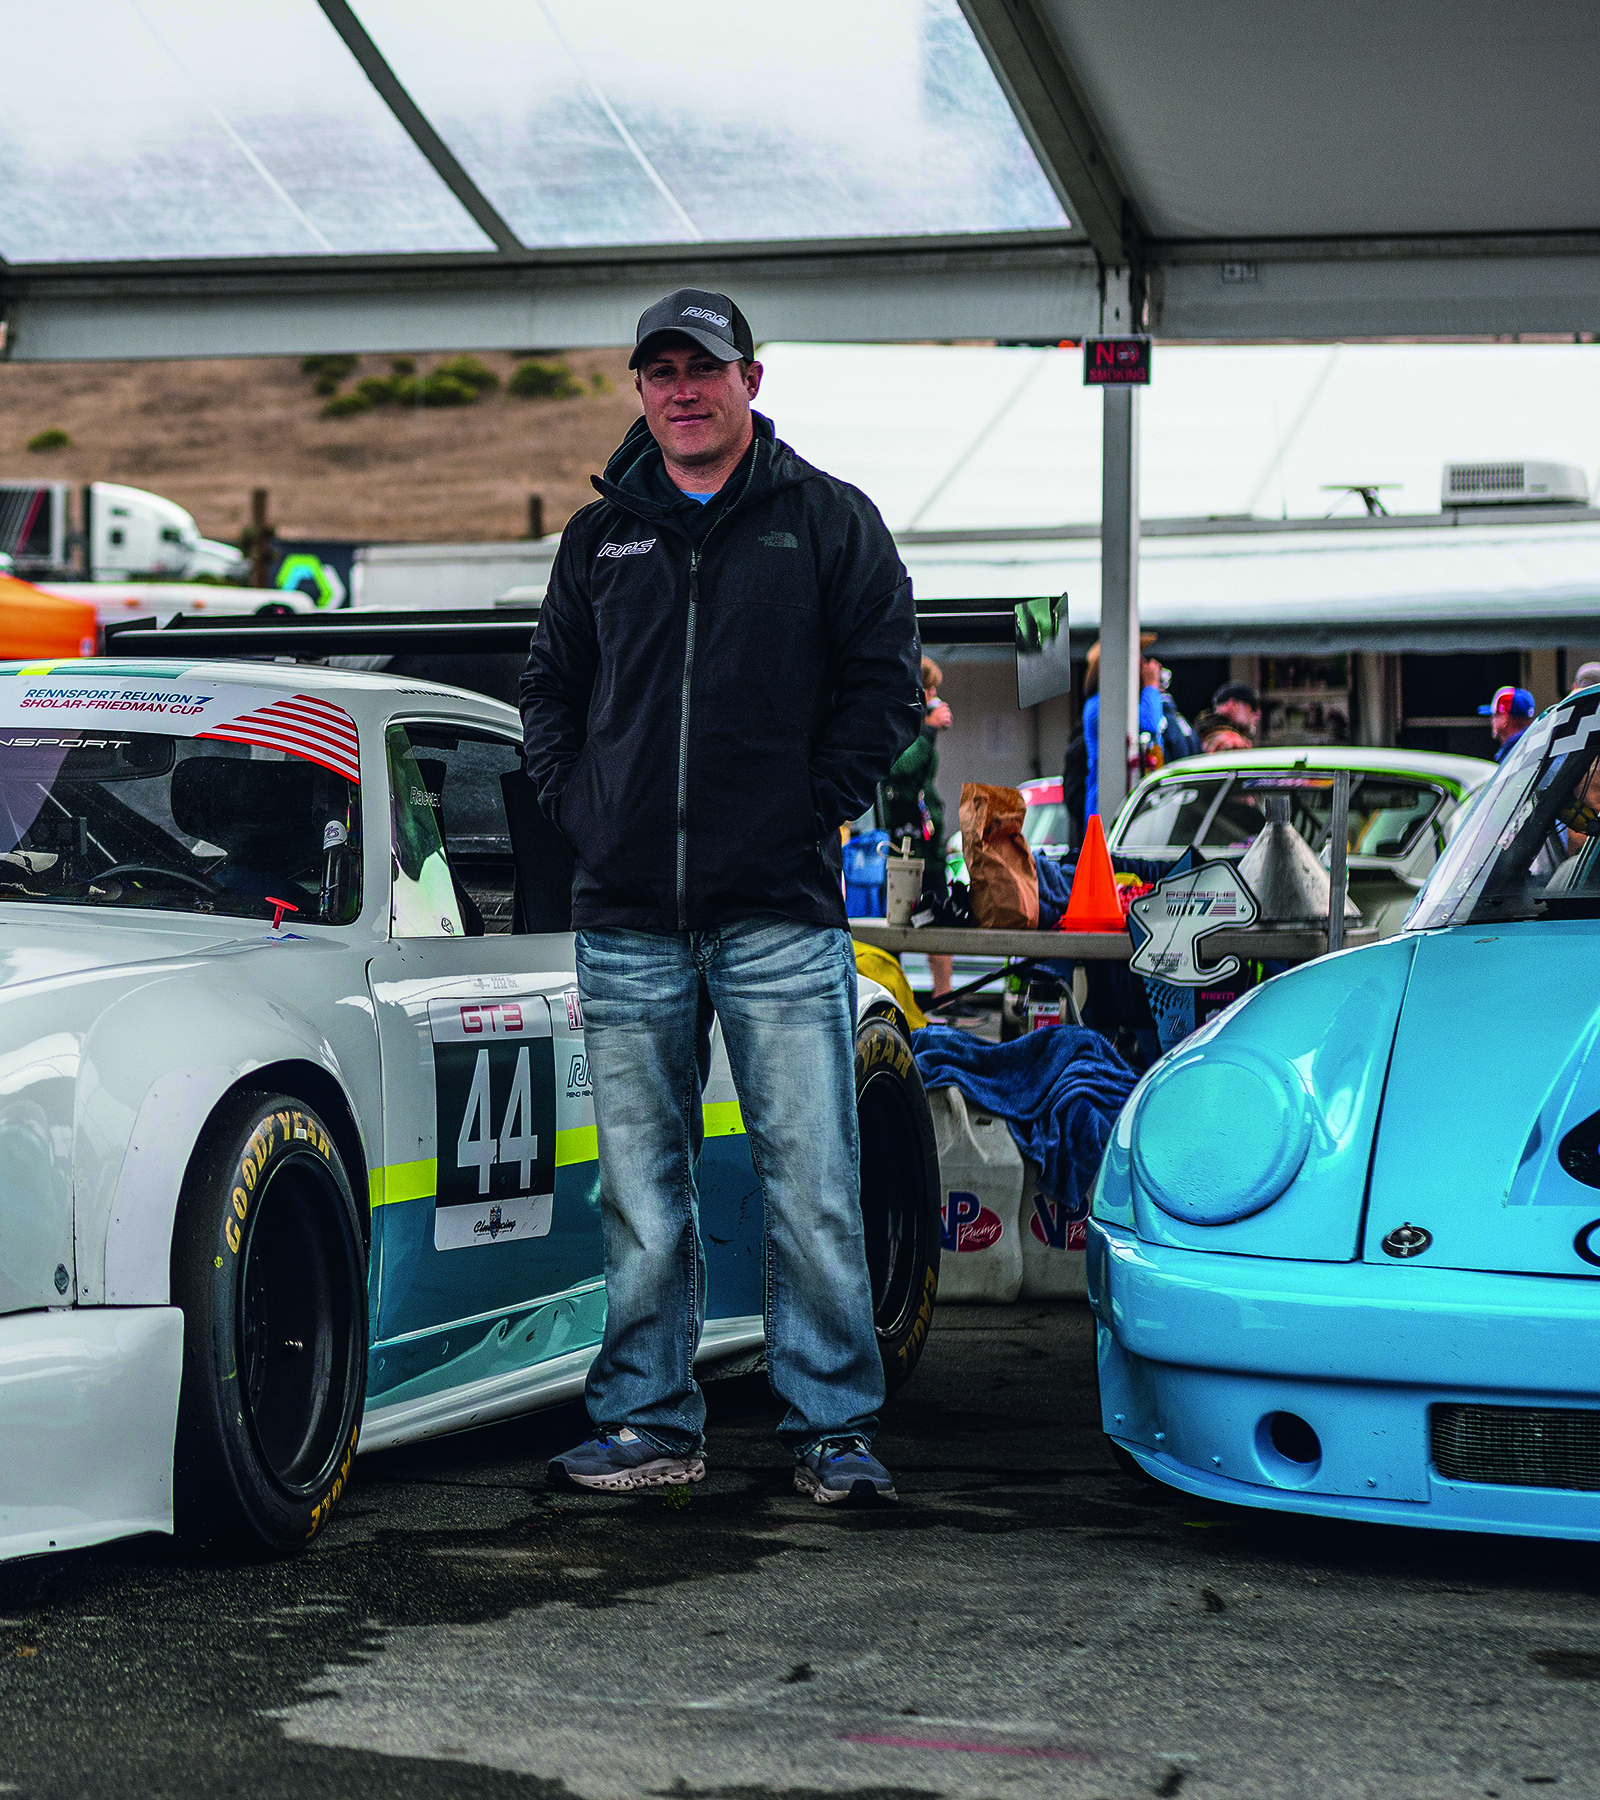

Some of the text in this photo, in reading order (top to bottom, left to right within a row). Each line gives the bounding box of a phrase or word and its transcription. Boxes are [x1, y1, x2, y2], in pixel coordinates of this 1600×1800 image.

[680, 306, 730, 328] RRS
[1088, 367, 1147, 383] SMOKING
[597, 539, 657, 558] RRS
[24, 688, 214, 705] RENNSPORT REUNION 7
[19, 698, 205, 716] SHOLAR-FRIEDMAN CUP
[1165, 890, 1237, 900] PORSCHE
[1194, 898, 1215, 917] 7
[459, 1003, 524, 1034] GT3
[457, 1046, 538, 1195] 44
[225, 1110, 332, 1255] GOODYEAR
[959, 1220, 1003, 1246] Racing
